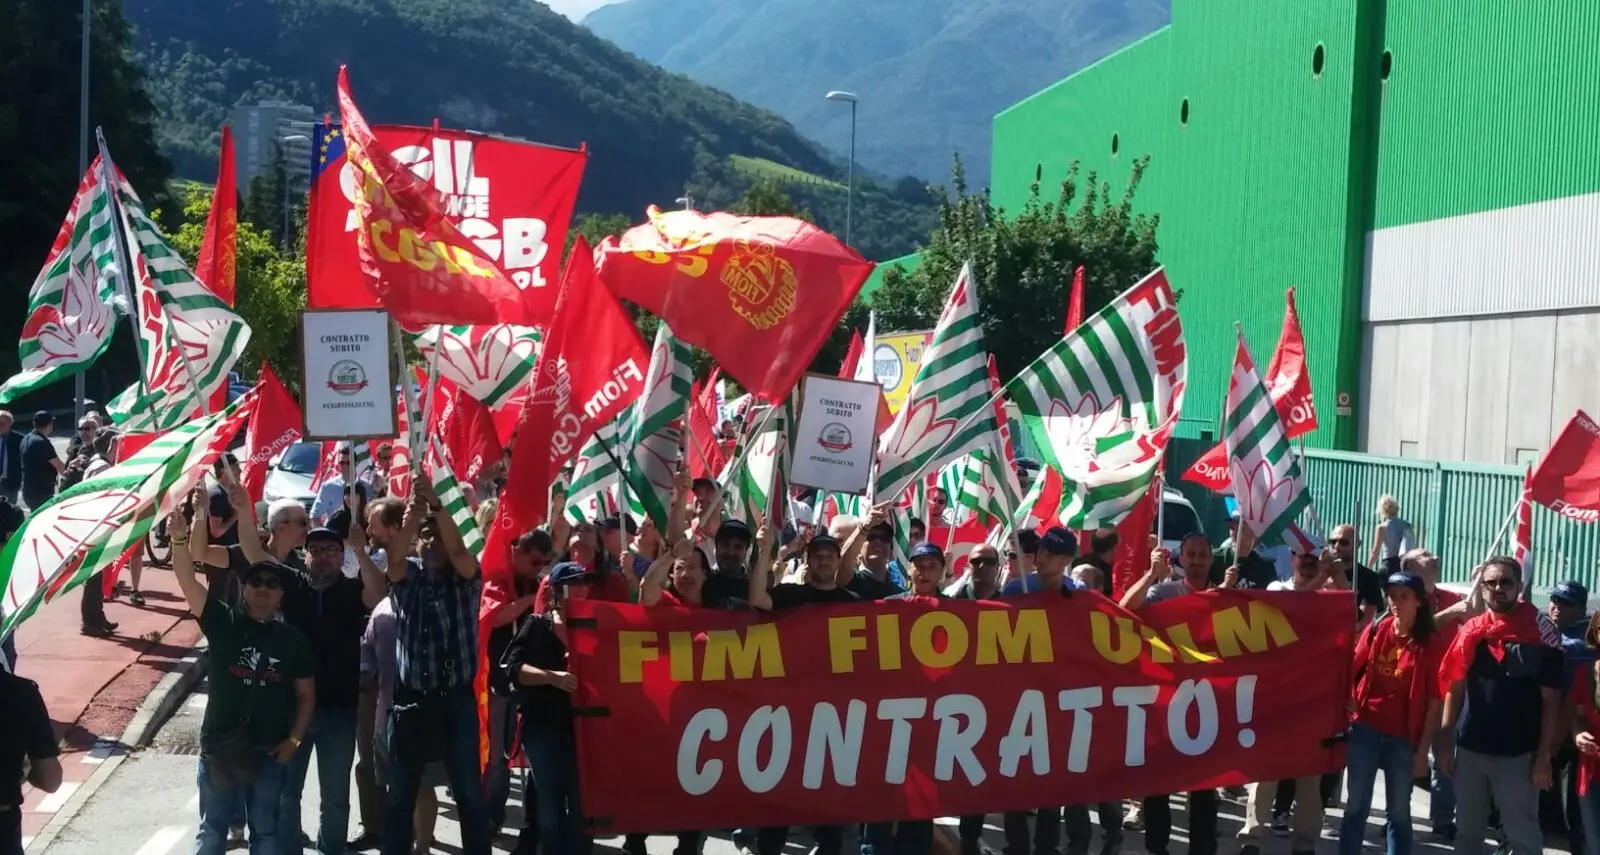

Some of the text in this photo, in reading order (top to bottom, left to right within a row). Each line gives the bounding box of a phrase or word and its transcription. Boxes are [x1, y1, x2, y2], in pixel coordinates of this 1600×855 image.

[320, 334, 370, 343] CONTRATTO
[330, 344, 361, 352] SUBITO
[820, 398, 862, 410] CONTRATTO
[826, 408, 853, 418] SUBITO
[618, 621, 786, 684] FIM
[828, 609, 1054, 674] FIOM
[676, 674, 1258, 796] CONTRATTO!
